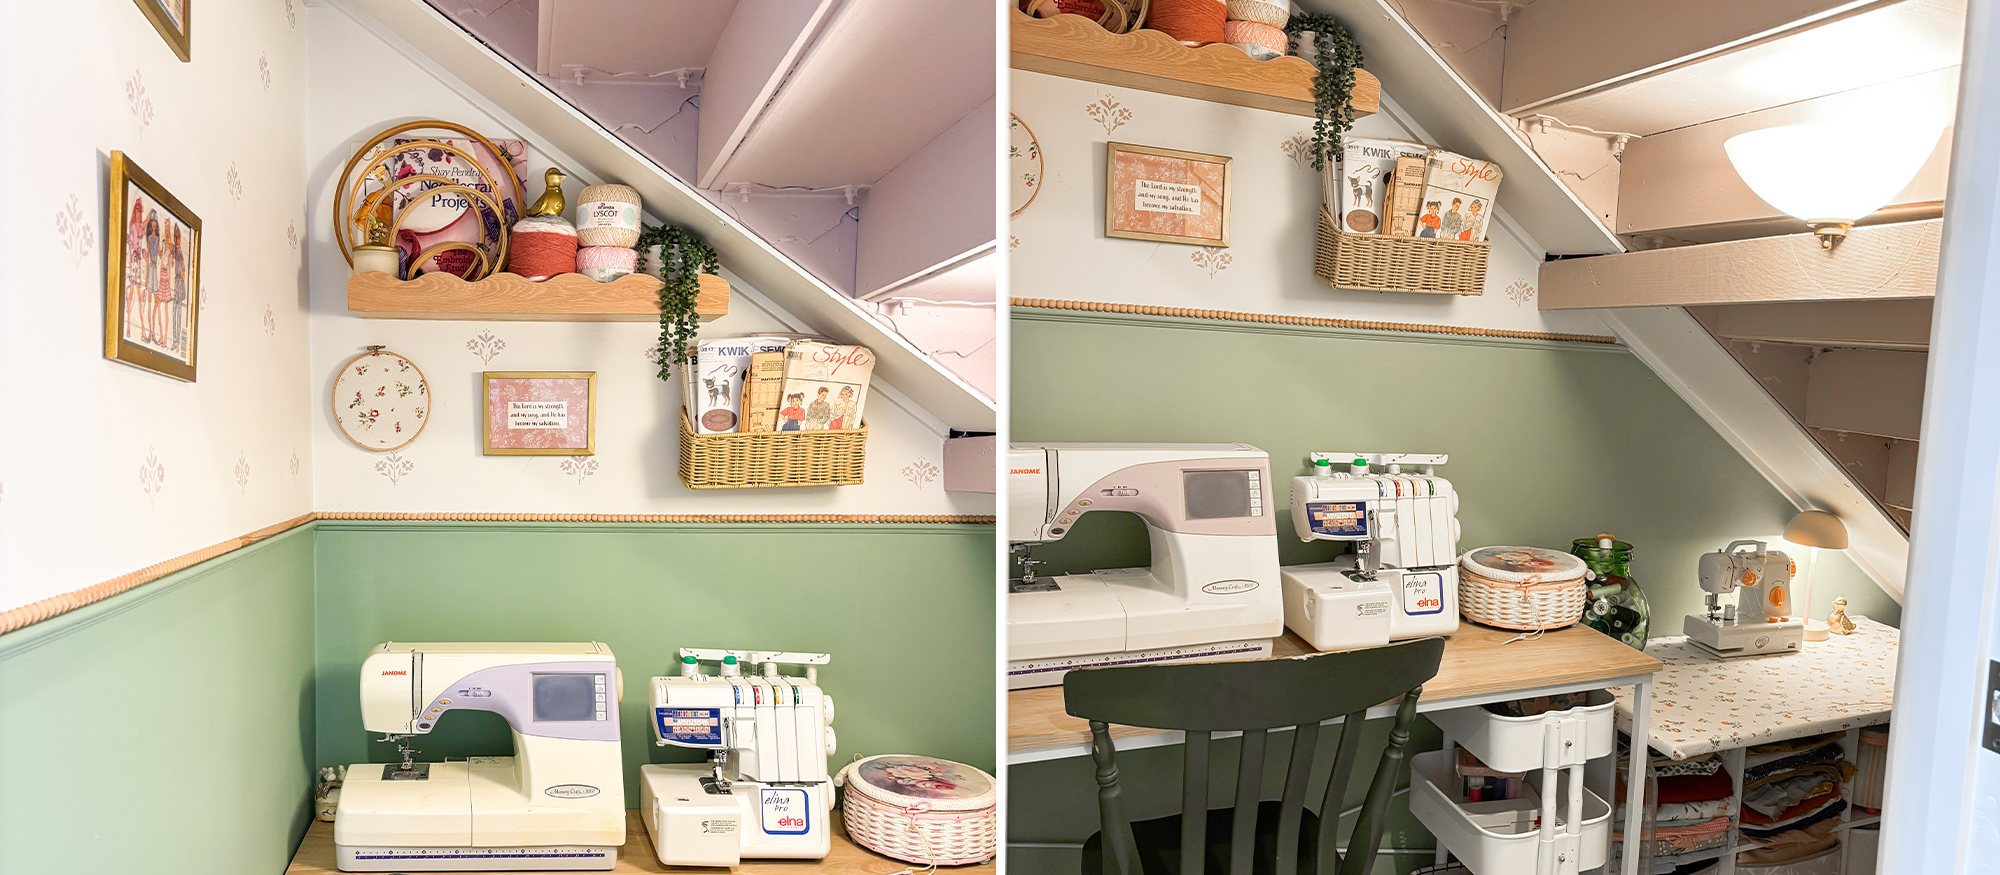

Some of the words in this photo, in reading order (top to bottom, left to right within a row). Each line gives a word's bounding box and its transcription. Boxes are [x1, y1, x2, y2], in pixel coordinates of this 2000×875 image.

[1362, 146, 1391, 159] KWIK
[430, 166, 450, 178] Shay
[1451, 158, 1497, 188] Style
[593, 210, 618, 218] LYSCOT
[718, 346, 750, 356] KWIK
[812, 345, 870, 376] Style
[1405, 575, 1427, 589] elina
[1416, 597, 1439, 608] elna
[764, 790, 790, 805] elina
[777, 815, 804, 827] elna
